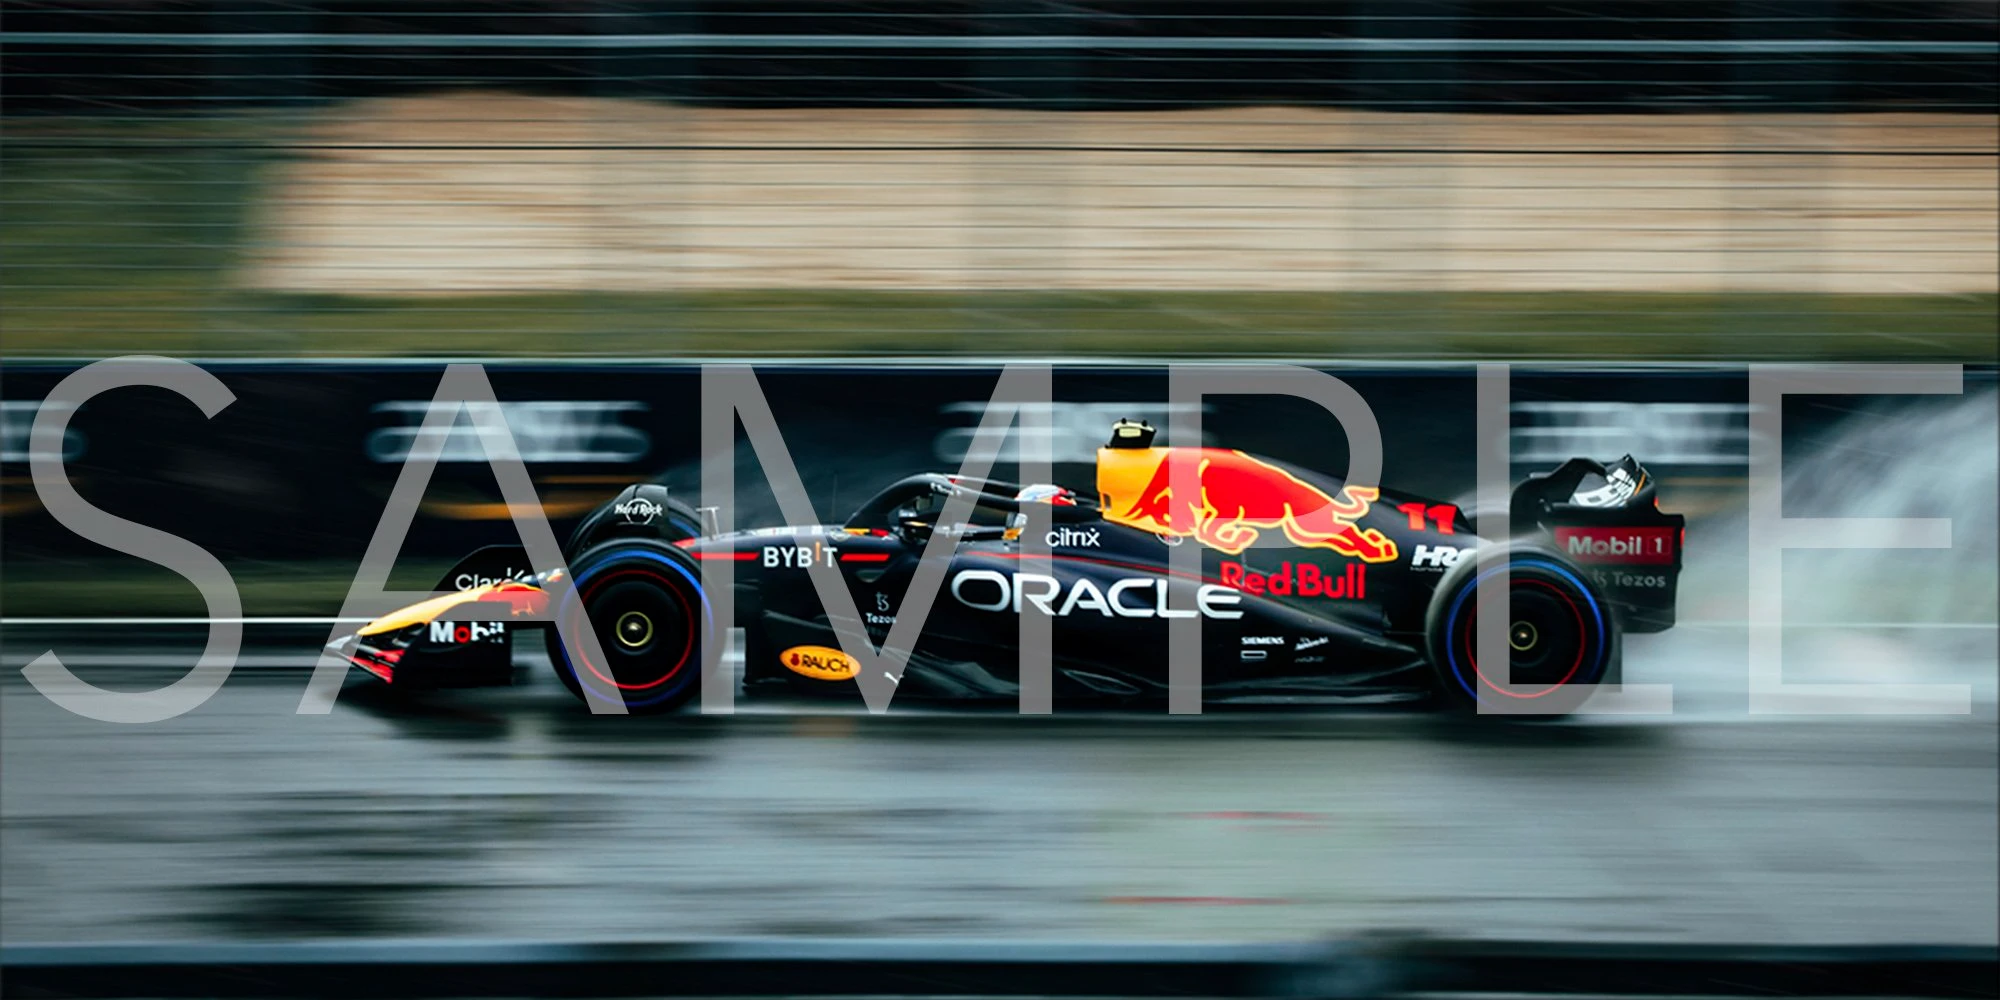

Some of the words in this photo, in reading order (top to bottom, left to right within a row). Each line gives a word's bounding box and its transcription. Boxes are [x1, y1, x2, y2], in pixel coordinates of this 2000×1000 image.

[614, 503, 639, 514] Hard
[640, 503, 663, 517] Rock
[1396, 502, 1456, 535] 11
[1045, 527, 1100, 547] citrix
[1567, 535, 1642, 555] Mobil
[1654, 537, 1663, 553] 1
[763, 541, 838, 568] BYBIT
[455, 573, 513, 591] Clar
[1220, 561, 1292, 597] Red
[1297, 563, 1366, 599] Bull
[1612, 571, 1666, 587] Tezos
[951, 569, 1244, 619] ORACLE
[801, 654, 850, 672] RAUCH
